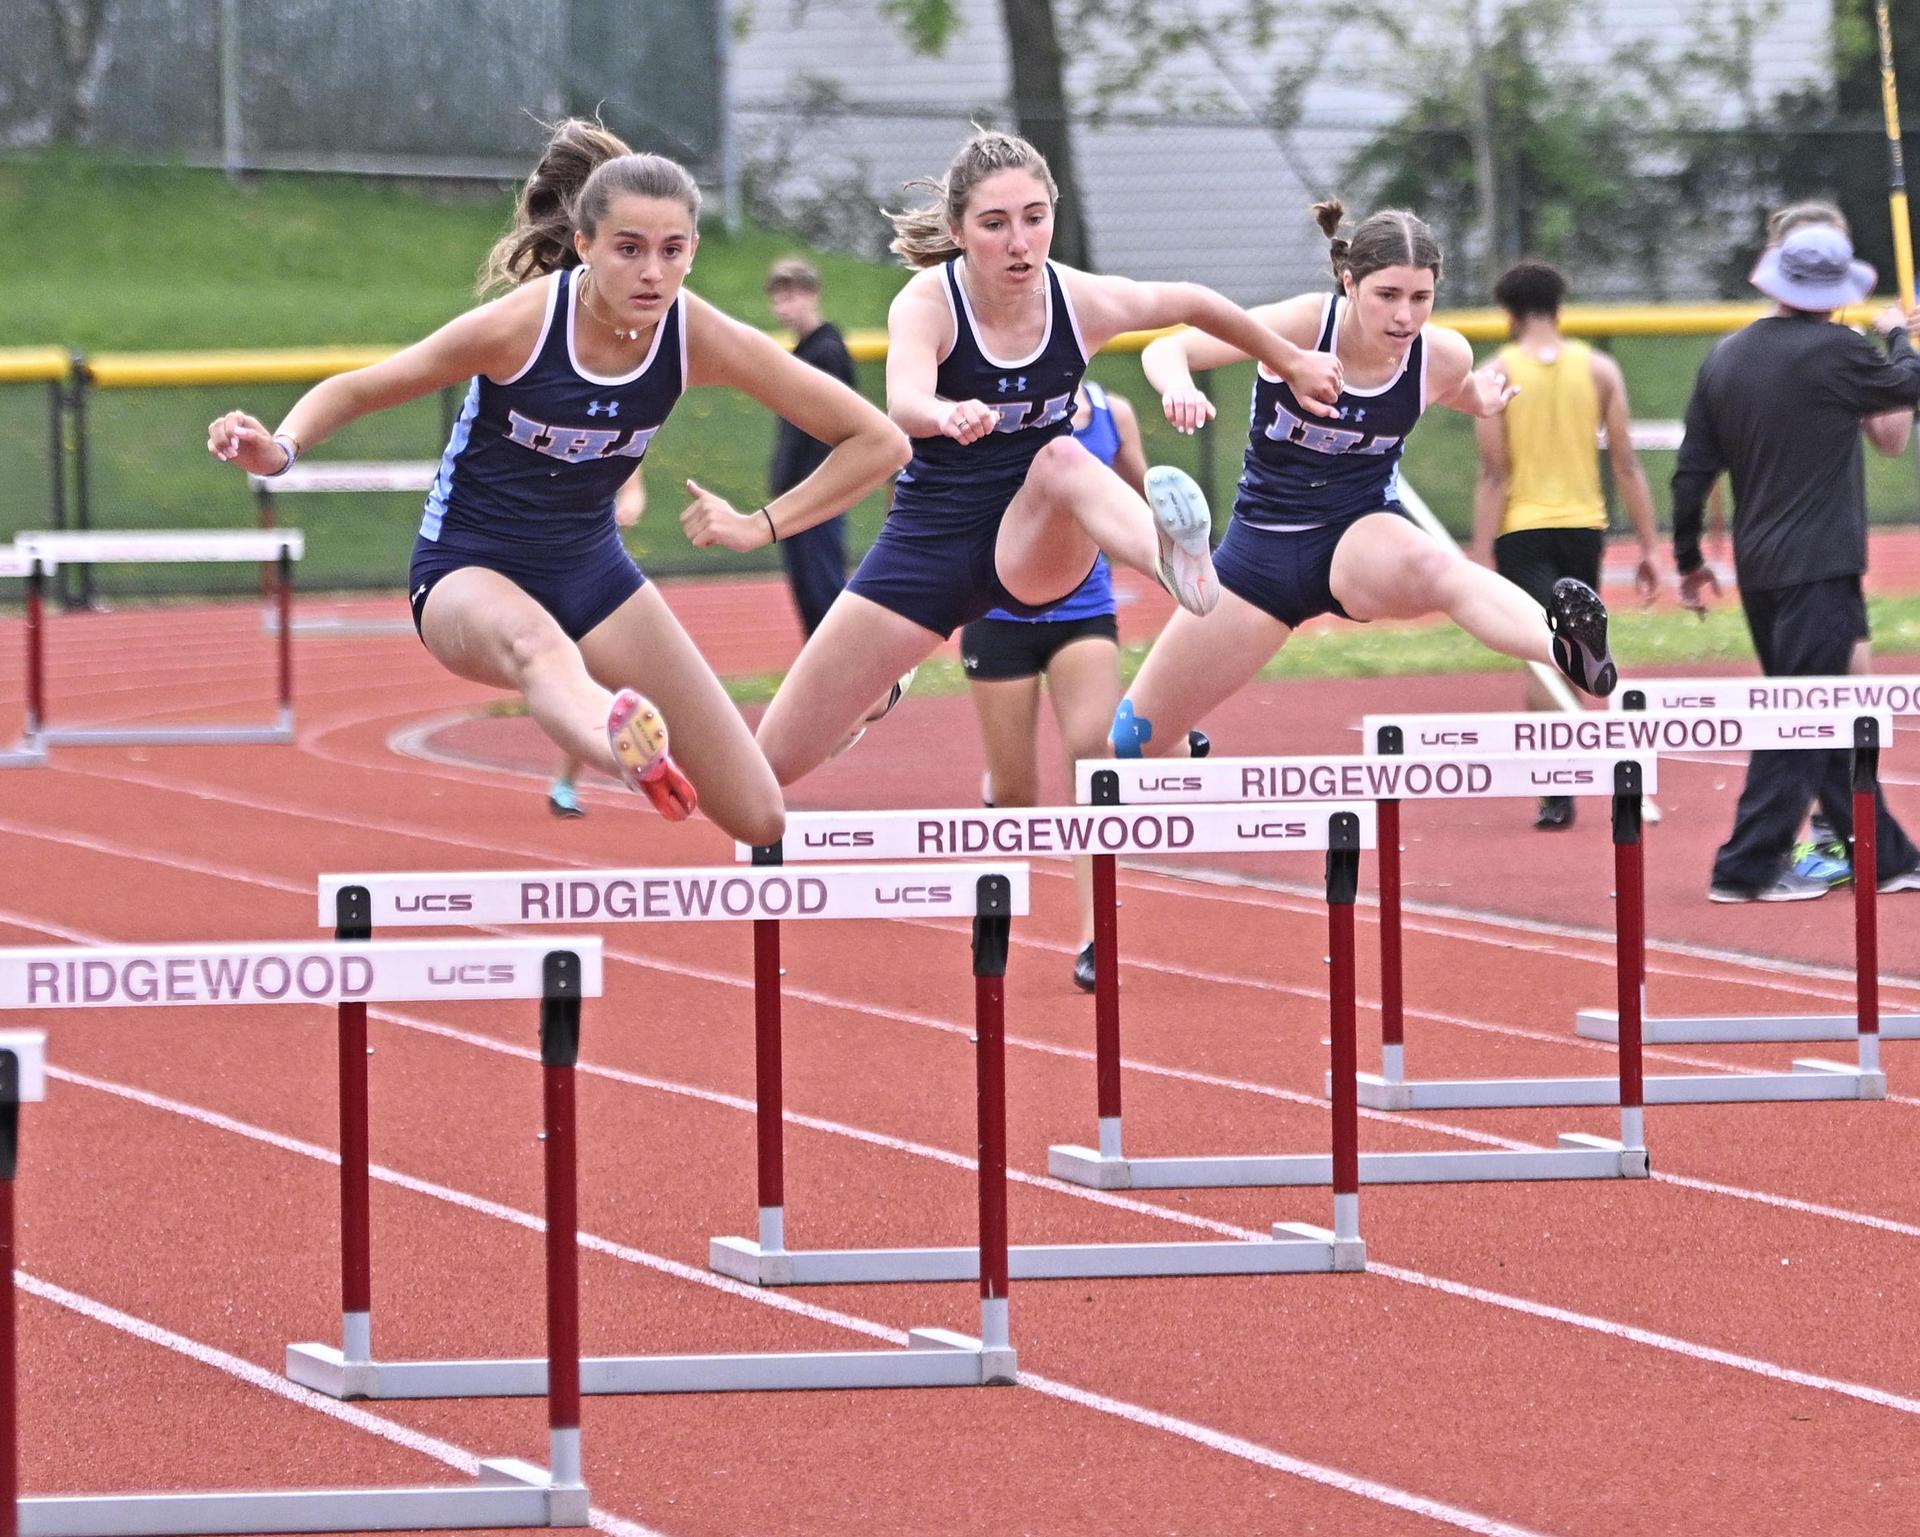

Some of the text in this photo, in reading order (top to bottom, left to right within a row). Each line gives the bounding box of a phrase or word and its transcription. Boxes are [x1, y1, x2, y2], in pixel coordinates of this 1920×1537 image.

[1662, 696, 1716, 709] UCS
[1420, 719, 1835, 751] UCS RIDGEWOOD UCS
[1138, 763, 1594, 798] UCS RIDGEWOOD UCS
[804, 815, 1307, 855] UCS RIDGEWOOD UCS
[395, 877, 952, 922] UCS RIDGEWOOD UCS
[27, 955, 515, 1004] RIDGEWOOD UCS
